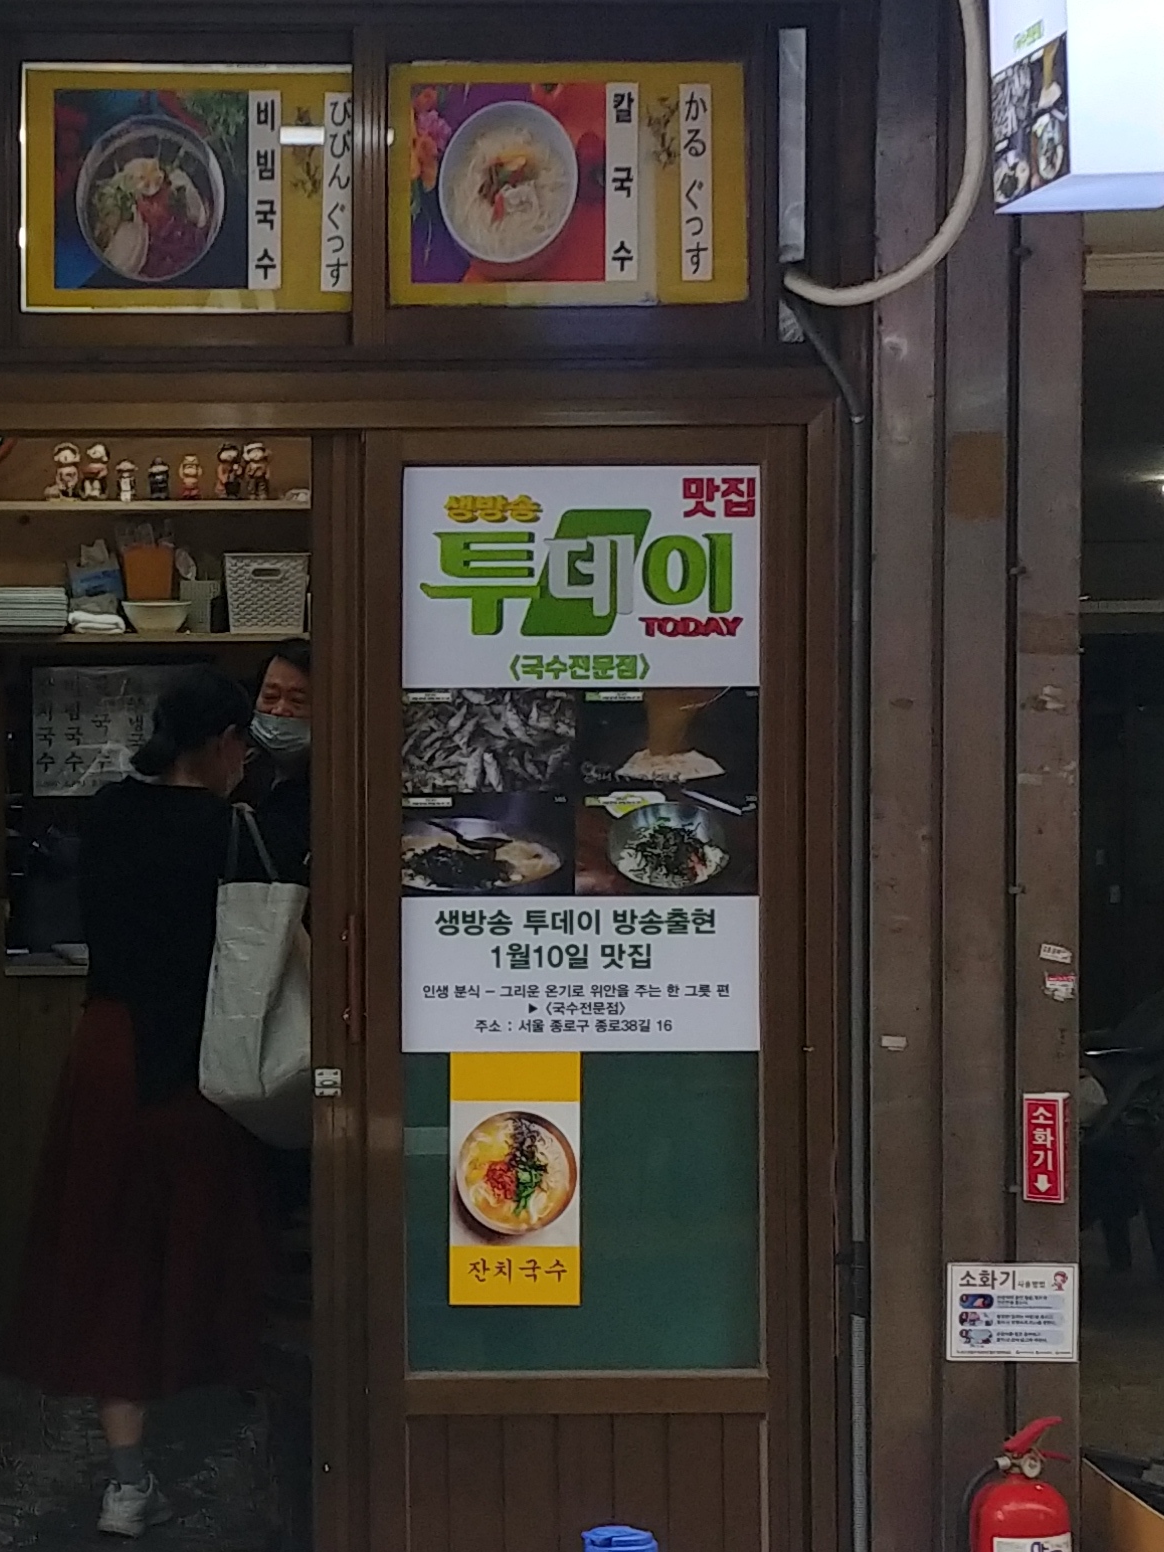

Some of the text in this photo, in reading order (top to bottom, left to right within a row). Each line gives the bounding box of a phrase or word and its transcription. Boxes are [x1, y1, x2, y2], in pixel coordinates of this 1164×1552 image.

[255, 99, 277, 280] 비빔국수
[611, 91, 635, 273] 칼국수
[444, 494, 544, 524] 생방송
[682, 477, 756, 519] 맛집
[419, 520, 734, 637] 투데이
[638, 616, 744, 638] TODAY
[434, 907, 717, 937] 생방송 투데이 방송출현
[490, 943, 653, 970] 1월10일 맛집
[422, 983, 449, 1000] 인생
[453, 983, 481, 1000] 분식
[499, 983, 540, 1000] 그리운
[544, 983, 585, 1000] 온기로
[589, 983, 630, 1000] 위안을
[634, 983, 662, 1000] 주는
[666, 983, 680, 1000] 한
[716, 983, 731, 1000] 편
[474, 1018, 502, 1034] 주소
[518, 1018, 545, 1034] 서울
[549, 1018, 590, 1034] 종로구
[594, 1018, 651, 1034] 종로38길
[656, 1019, 673, 1032] 16
[1030, 1106, 1055, 1172] 소화기
[467, 1258, 568, 1285] 잔치국수
[959, 1269, 1016, 1290] 소화기
